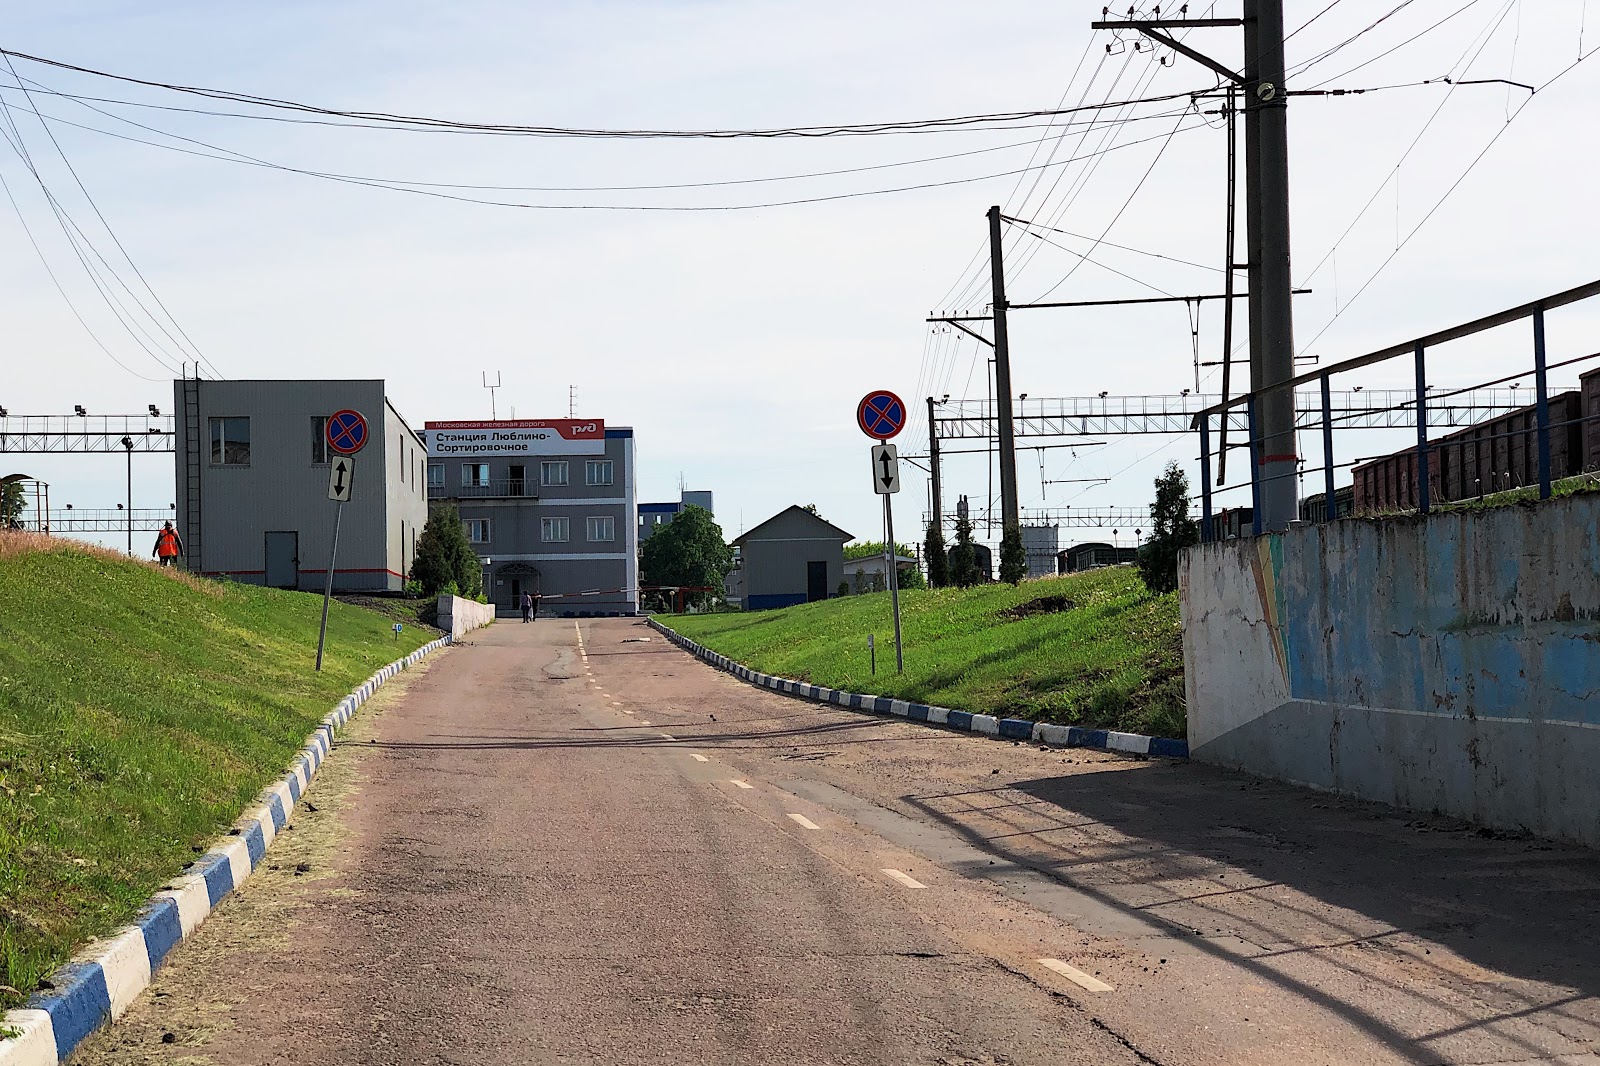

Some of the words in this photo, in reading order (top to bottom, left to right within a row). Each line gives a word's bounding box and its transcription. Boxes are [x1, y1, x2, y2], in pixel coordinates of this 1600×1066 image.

[436, 433, 487, 442] Станция
[491, 432, 551, 441] Люблино-
[436, 443, 529, 453] Сортировочное
